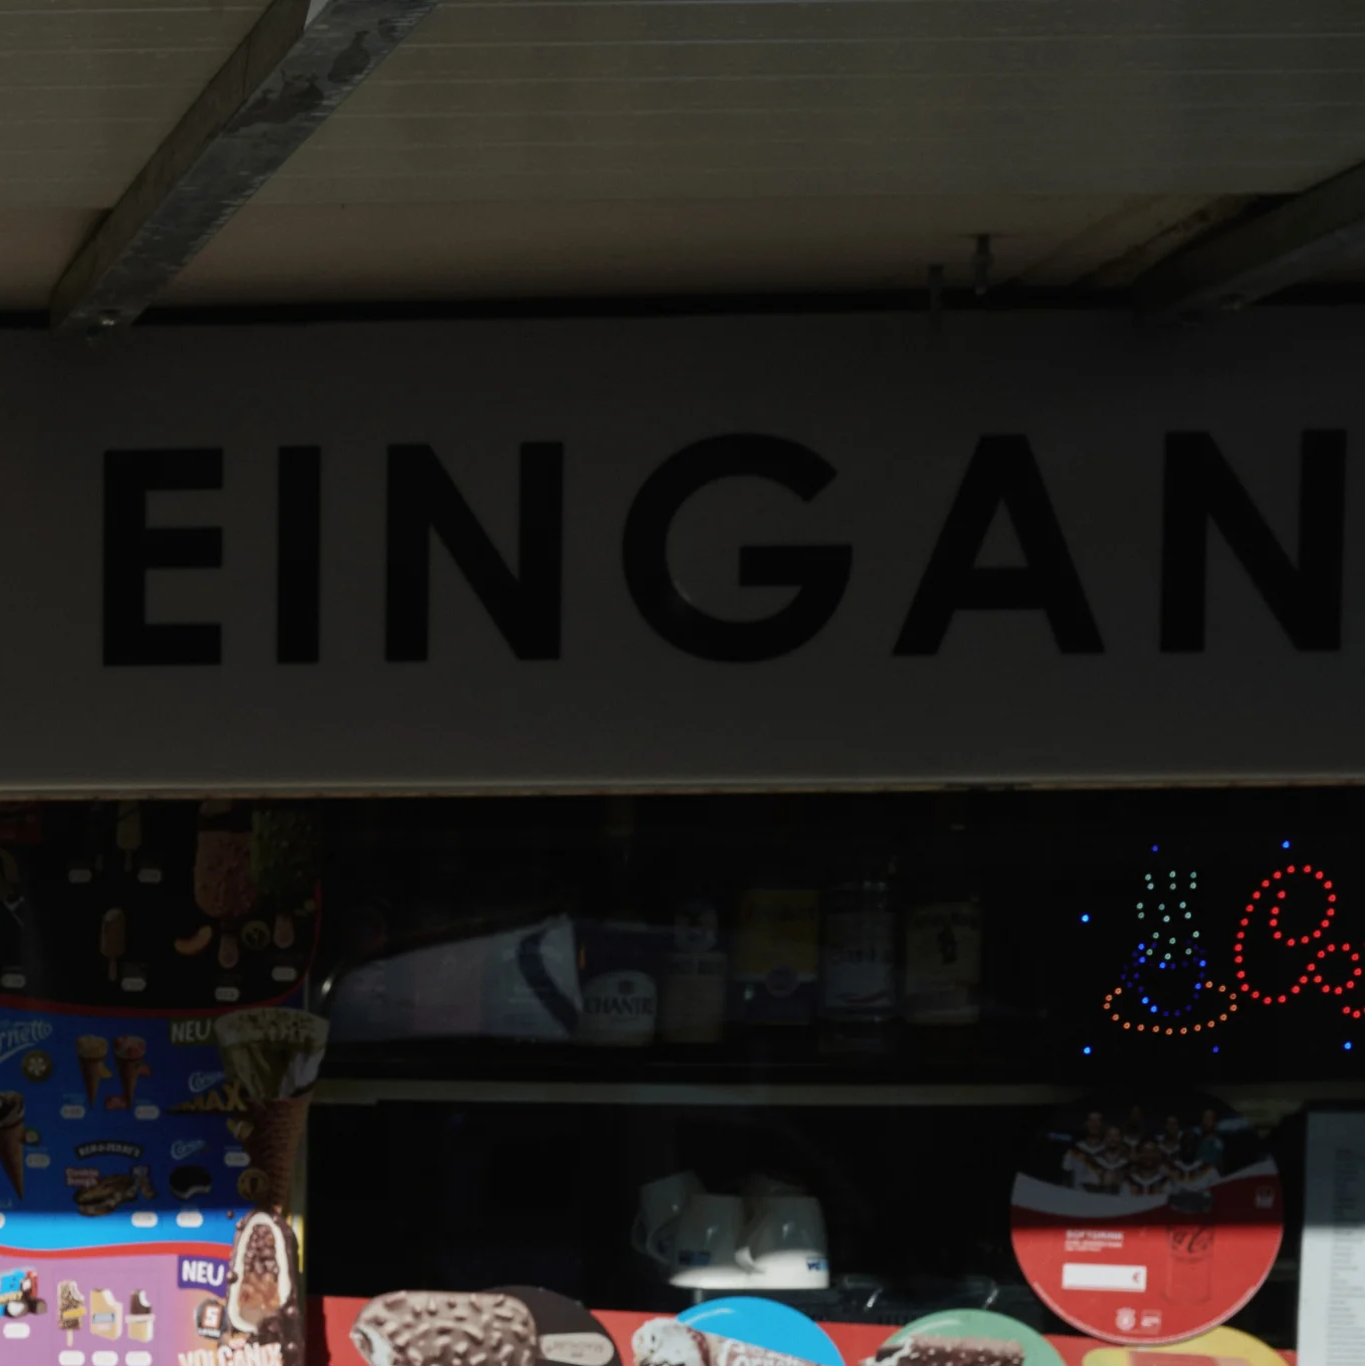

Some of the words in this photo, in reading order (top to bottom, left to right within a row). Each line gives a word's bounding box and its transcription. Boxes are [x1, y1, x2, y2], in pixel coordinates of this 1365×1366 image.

[103, 428, 1348, 666] EINGAN
[171, 1019, 211, 1043] NEU
[181, 1259, 225, 1286] NEU
